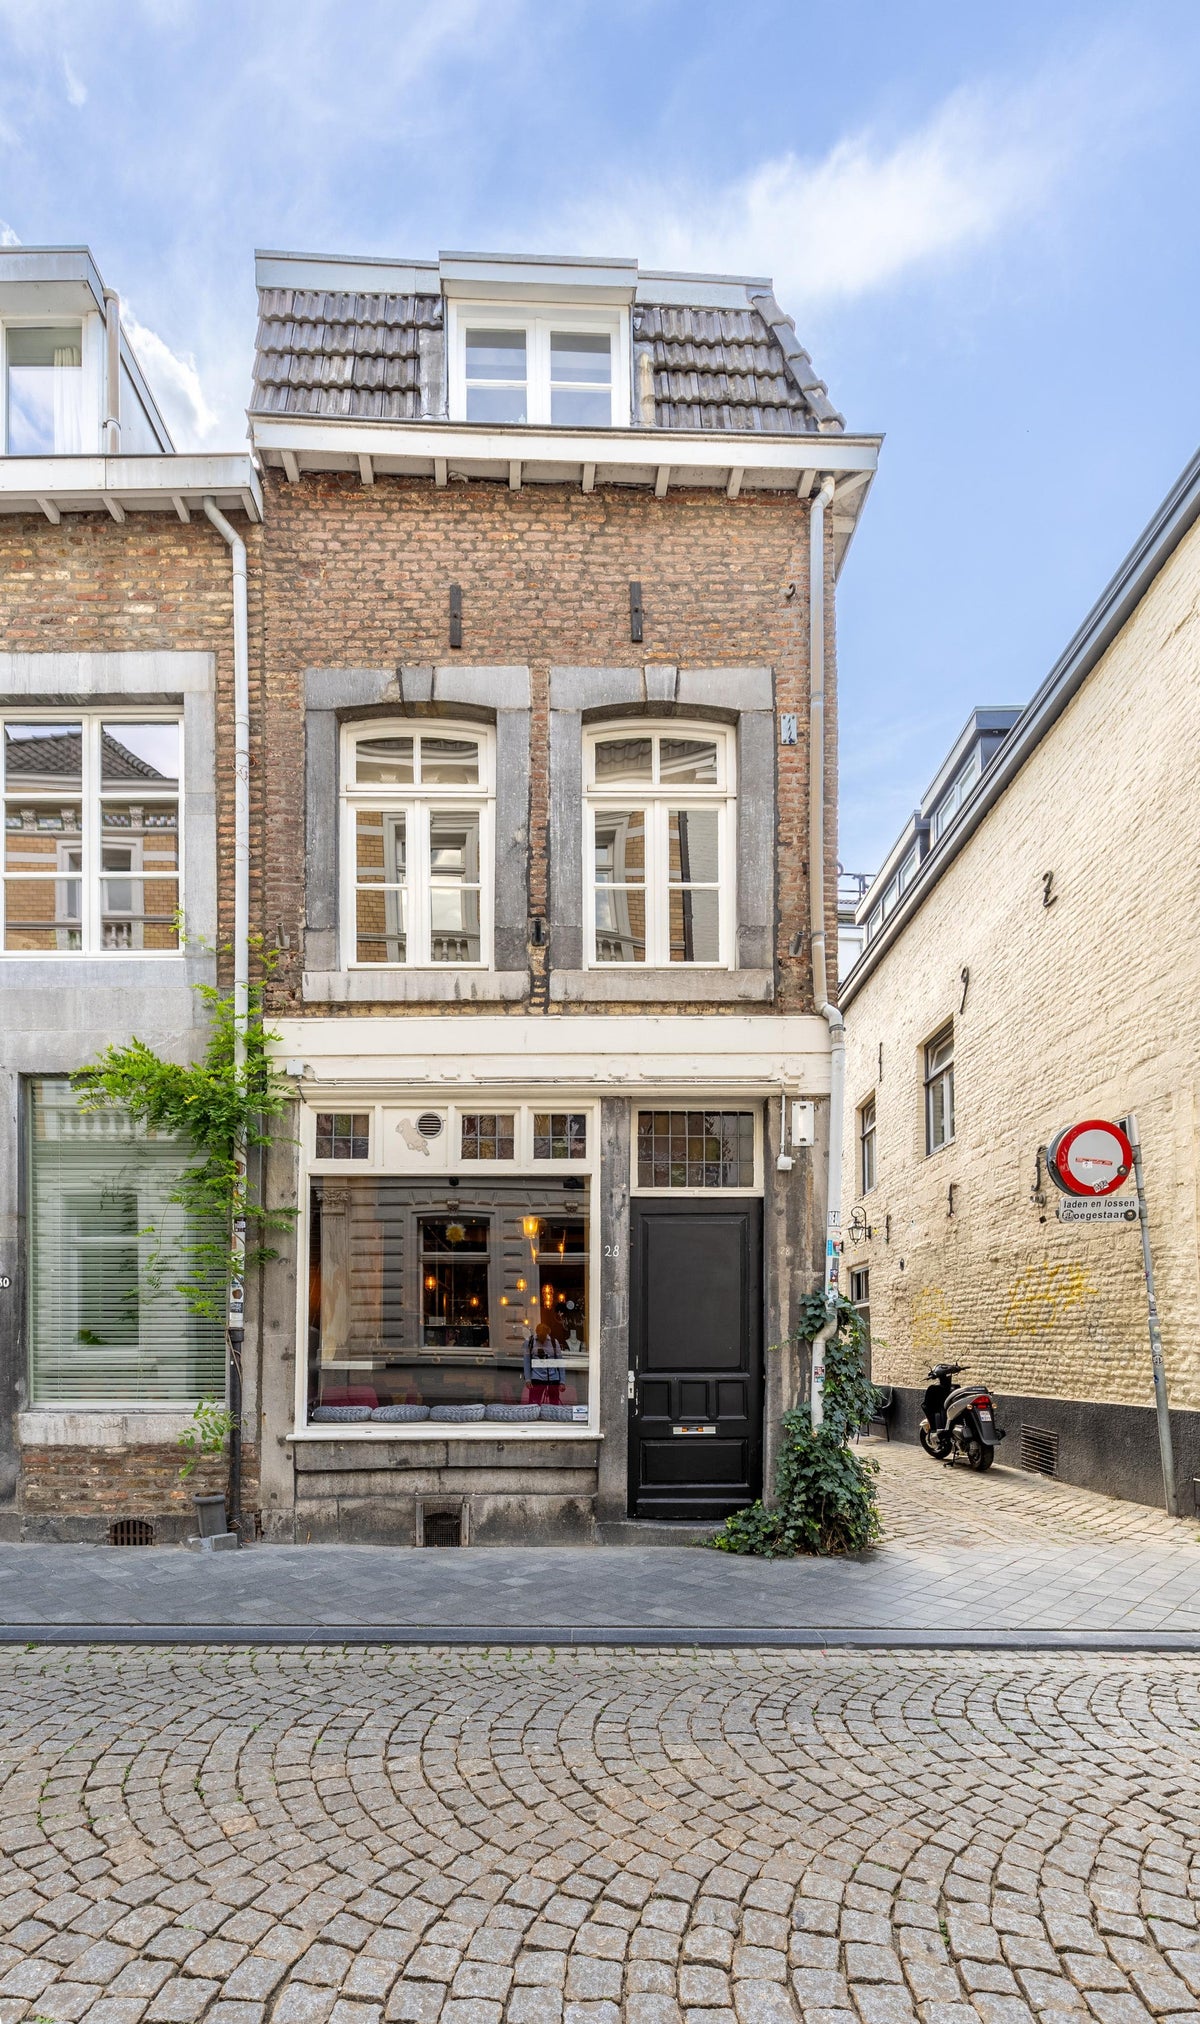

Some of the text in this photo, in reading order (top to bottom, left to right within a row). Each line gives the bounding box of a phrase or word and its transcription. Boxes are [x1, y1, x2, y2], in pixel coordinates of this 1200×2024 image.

[1063, 1200, 1088, 1208] laden
[1104, 1199, 1135, 1208] lossen
[604, 1245, 620, 1257] 28
